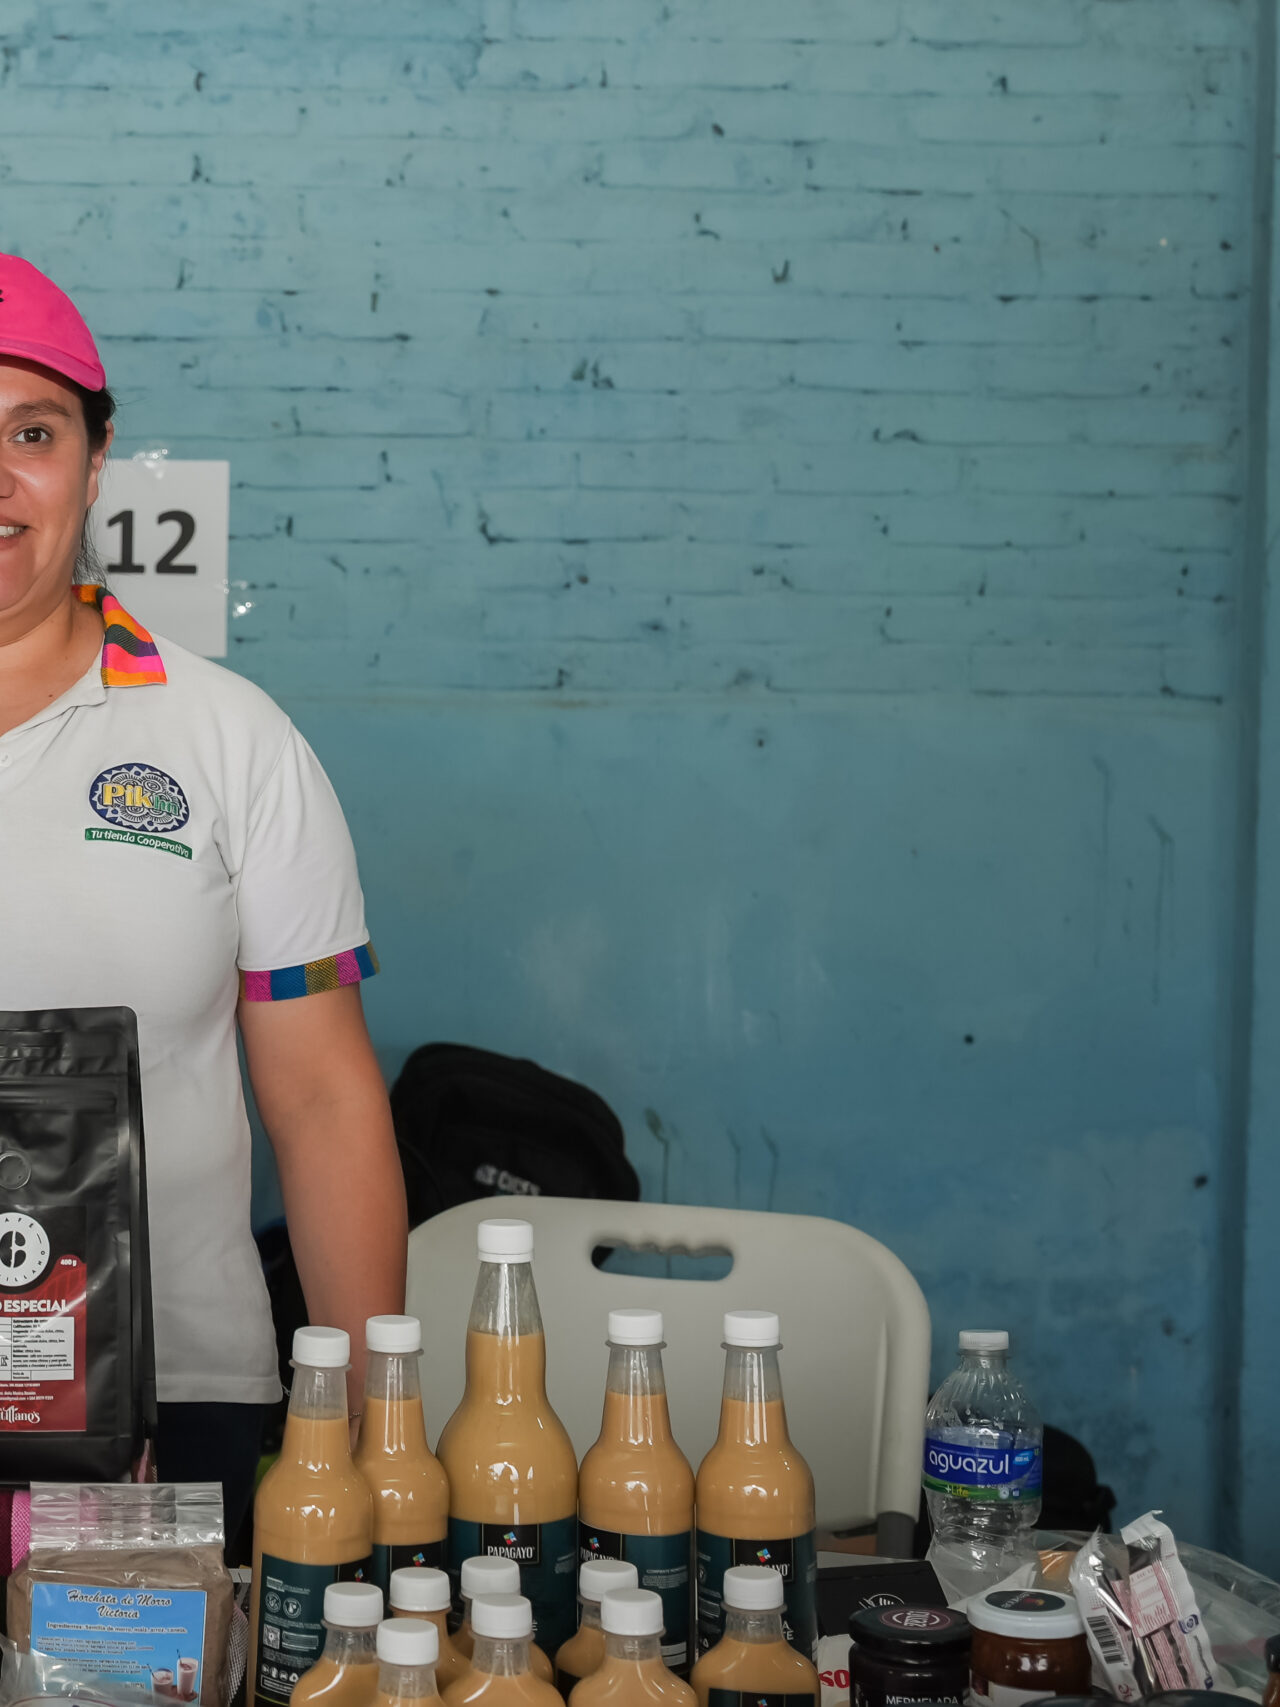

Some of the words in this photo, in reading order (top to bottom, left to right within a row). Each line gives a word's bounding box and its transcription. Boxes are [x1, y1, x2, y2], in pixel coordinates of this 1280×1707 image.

[106, 509, 198, 575] 12
[137, 835, 189, 857] Cooperativa
[4, 1299, 70, 1313] ESPECIAL
[929, 1450, 1009, 1475] aguazul
[487, 1545, 533, 1559] PAPAGAYO
[67, 1589, 117, 1604] Horchata
[121, 1594, 134, 1605] de
[136, 1594, 172, 1606] Morro
[97, 1605, 139, 1618] Victoria
